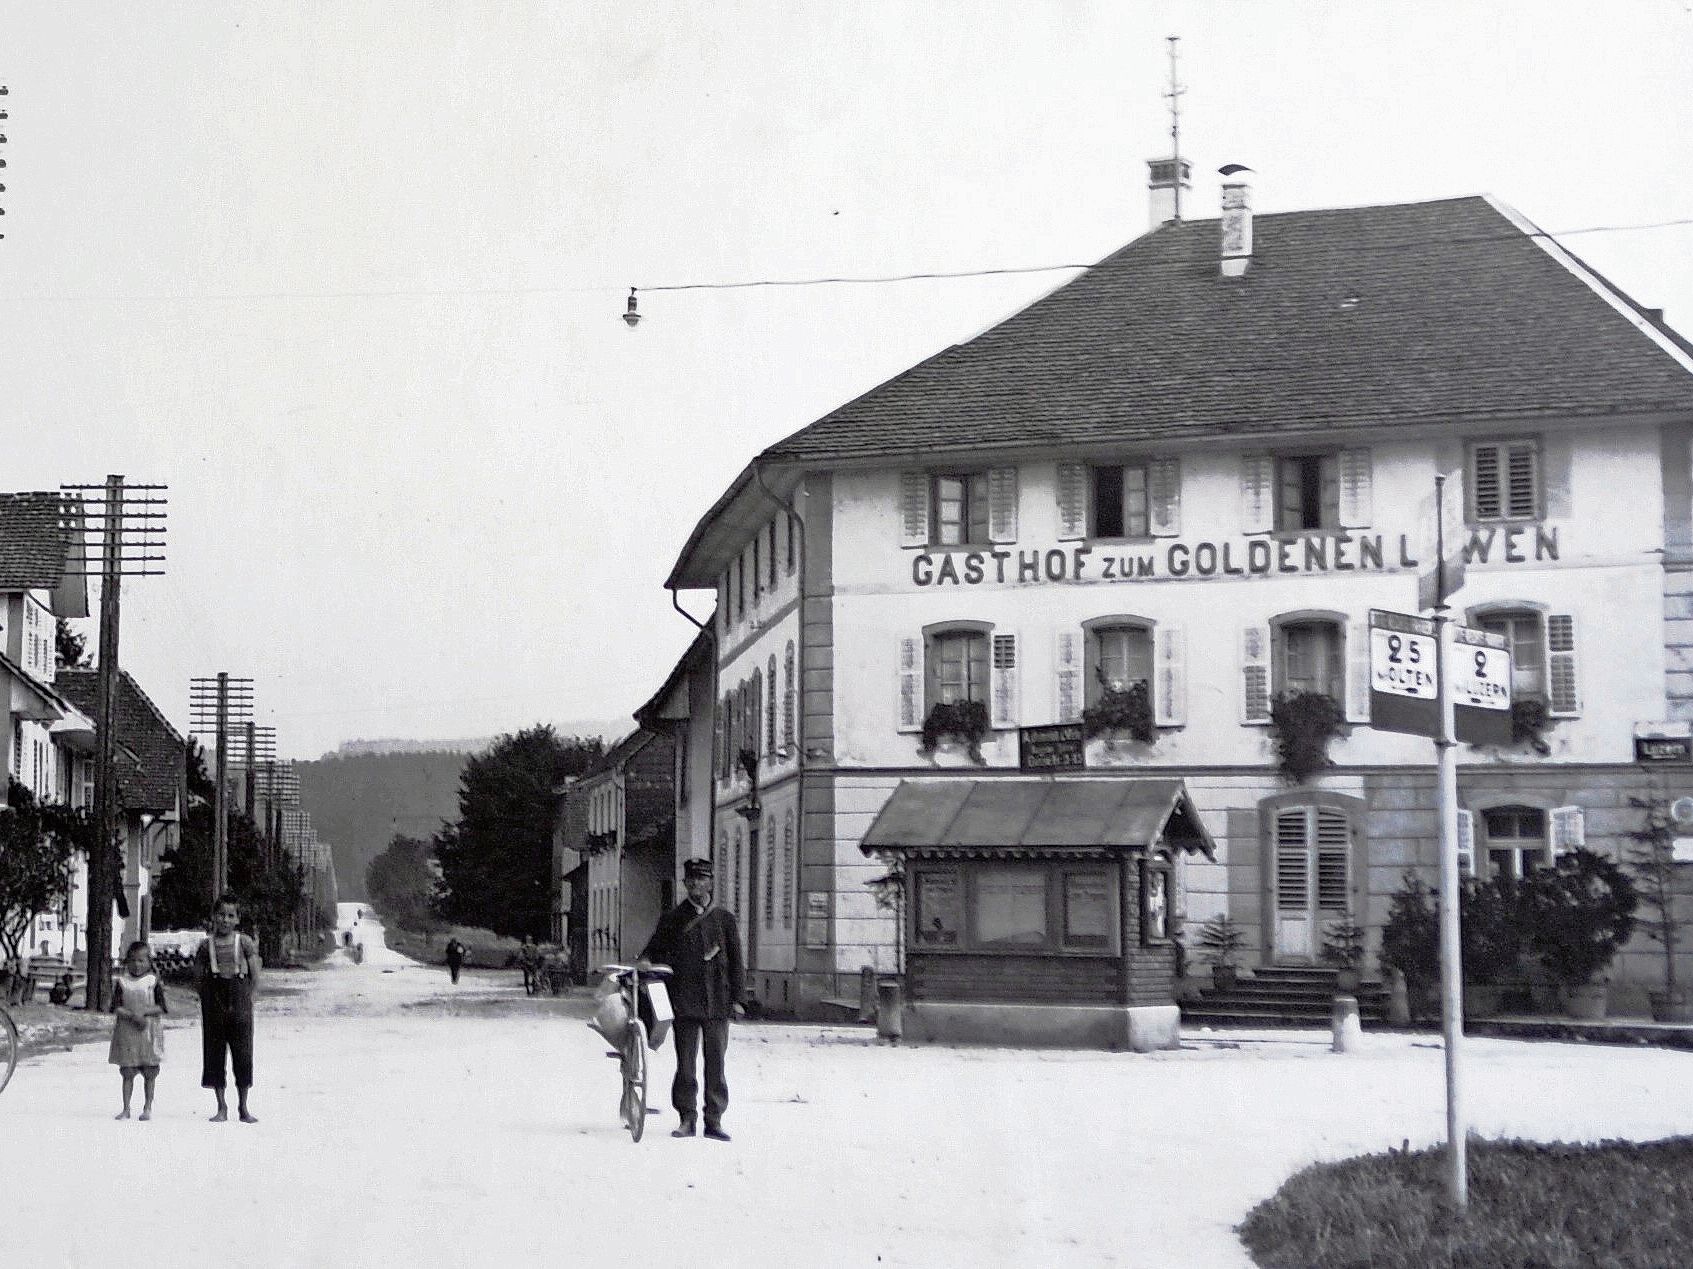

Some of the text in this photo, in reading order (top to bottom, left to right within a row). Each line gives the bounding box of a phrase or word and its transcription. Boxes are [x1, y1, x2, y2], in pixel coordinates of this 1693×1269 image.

[912, 525, 1559, 586] GASTHOF ZUM GOLDENEN LWEN
[1387, 634, 1421, 664] 25
[1474, 650, 1488, 679] 2
